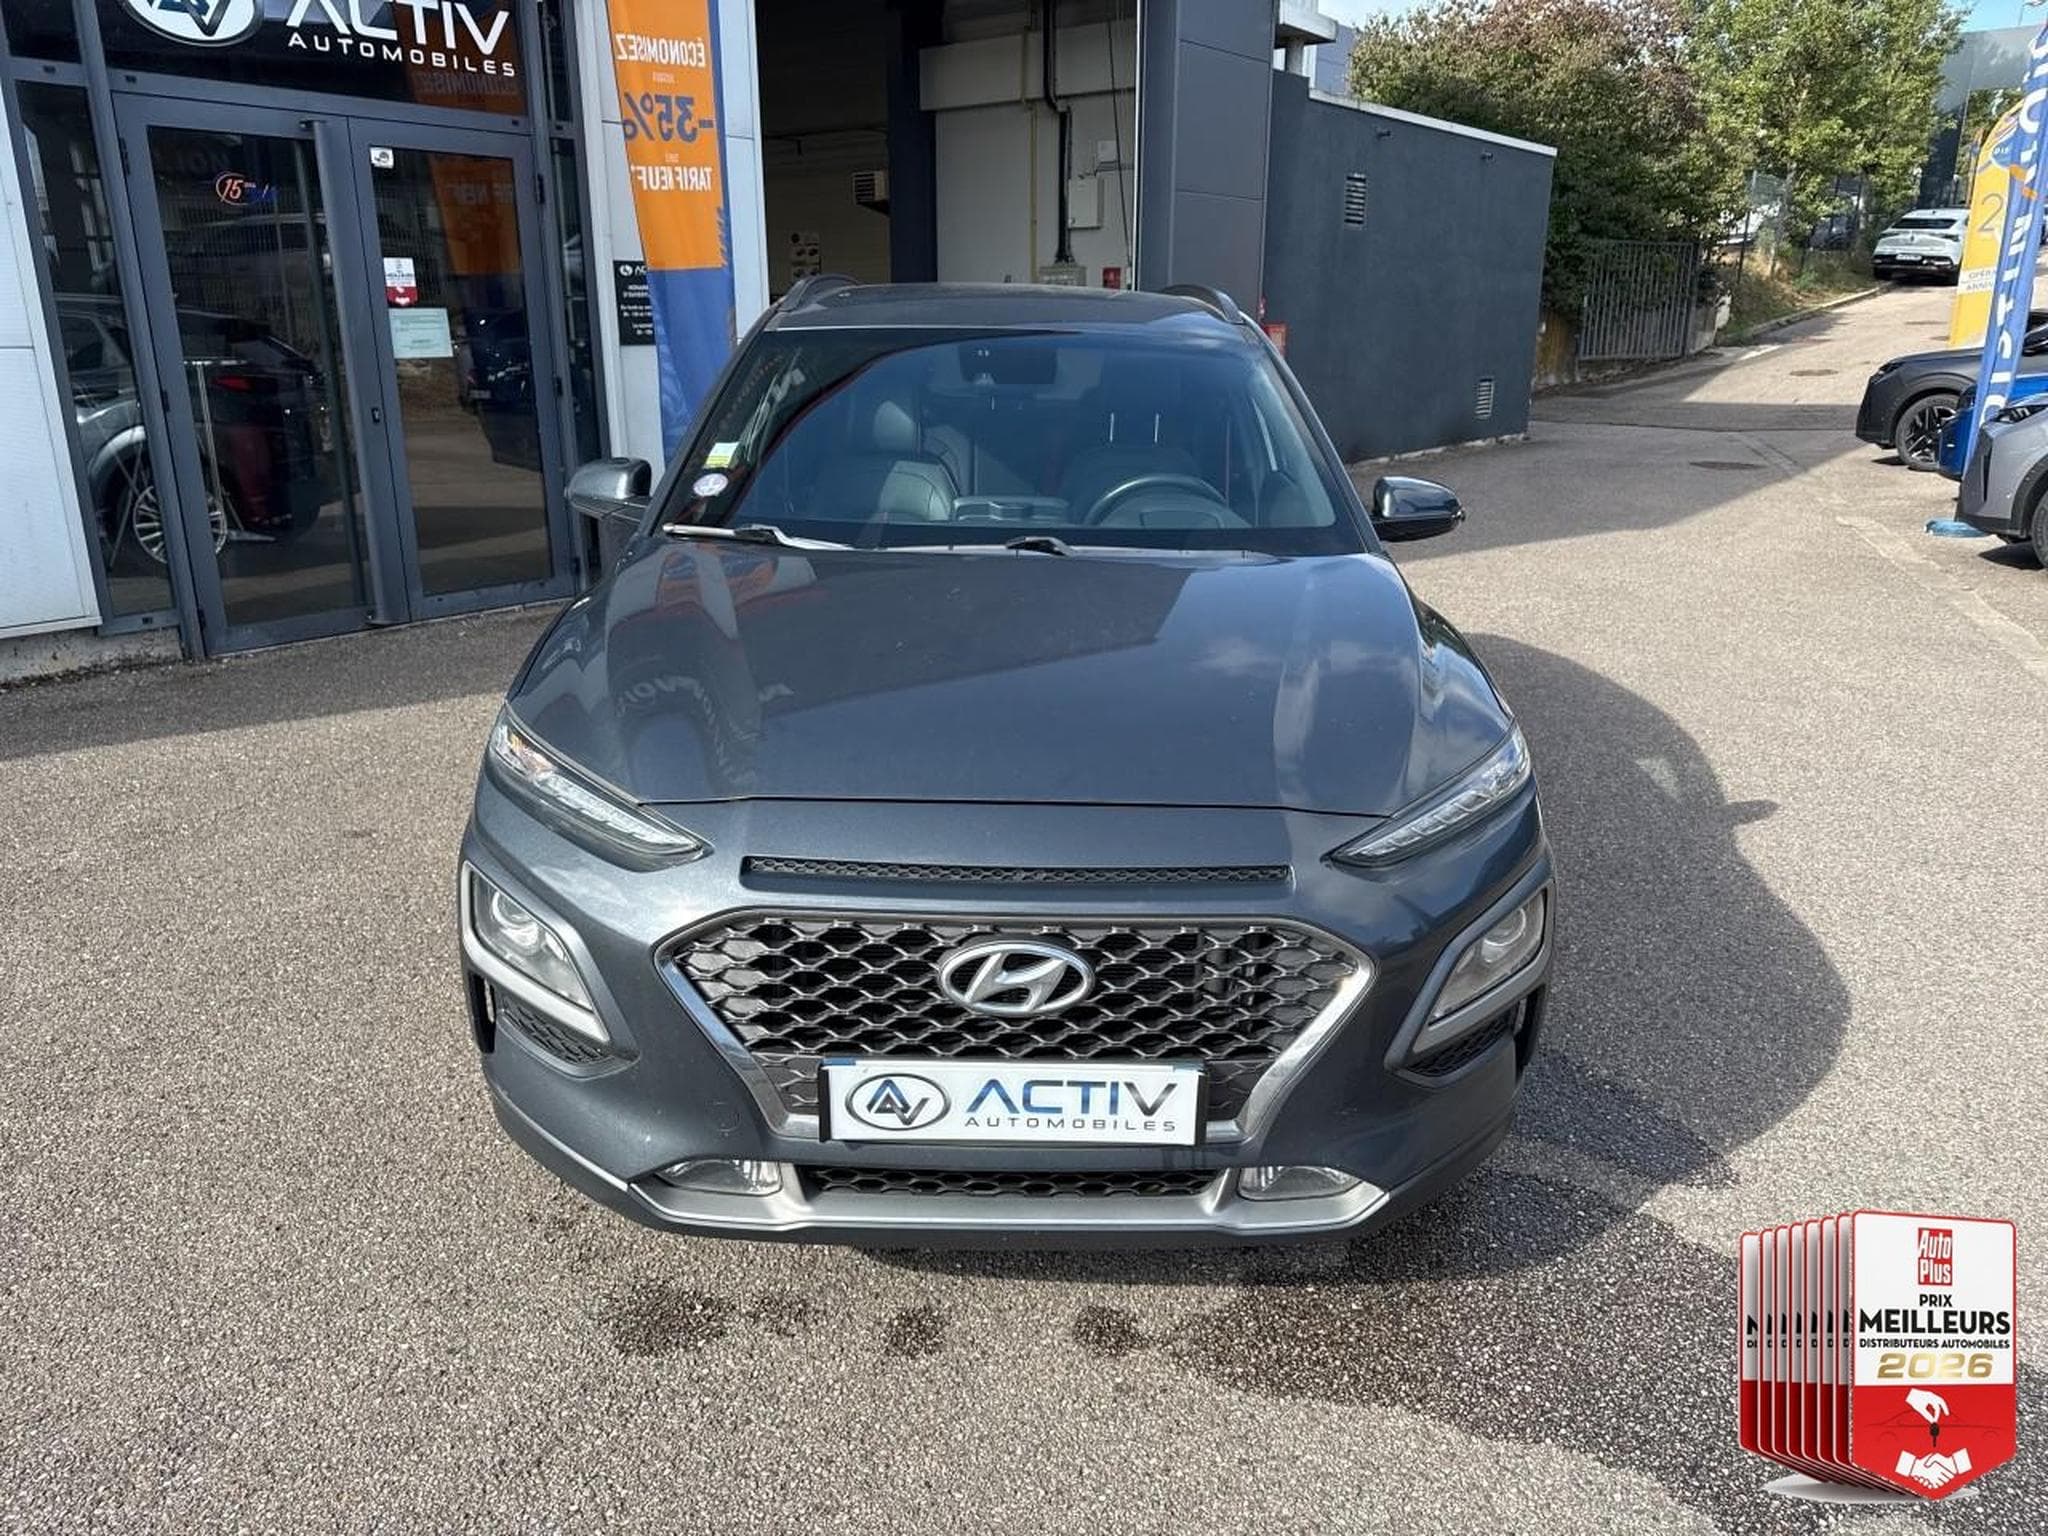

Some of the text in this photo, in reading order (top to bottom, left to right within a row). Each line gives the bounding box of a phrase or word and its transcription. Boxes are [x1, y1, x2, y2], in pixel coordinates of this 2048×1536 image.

[288, 32, 515, 77] AUTOMOBILES
[965, 1079, 1178, 1117] ACTIV
[964, 1117, 1176, 1132] AUTOMOBILES
